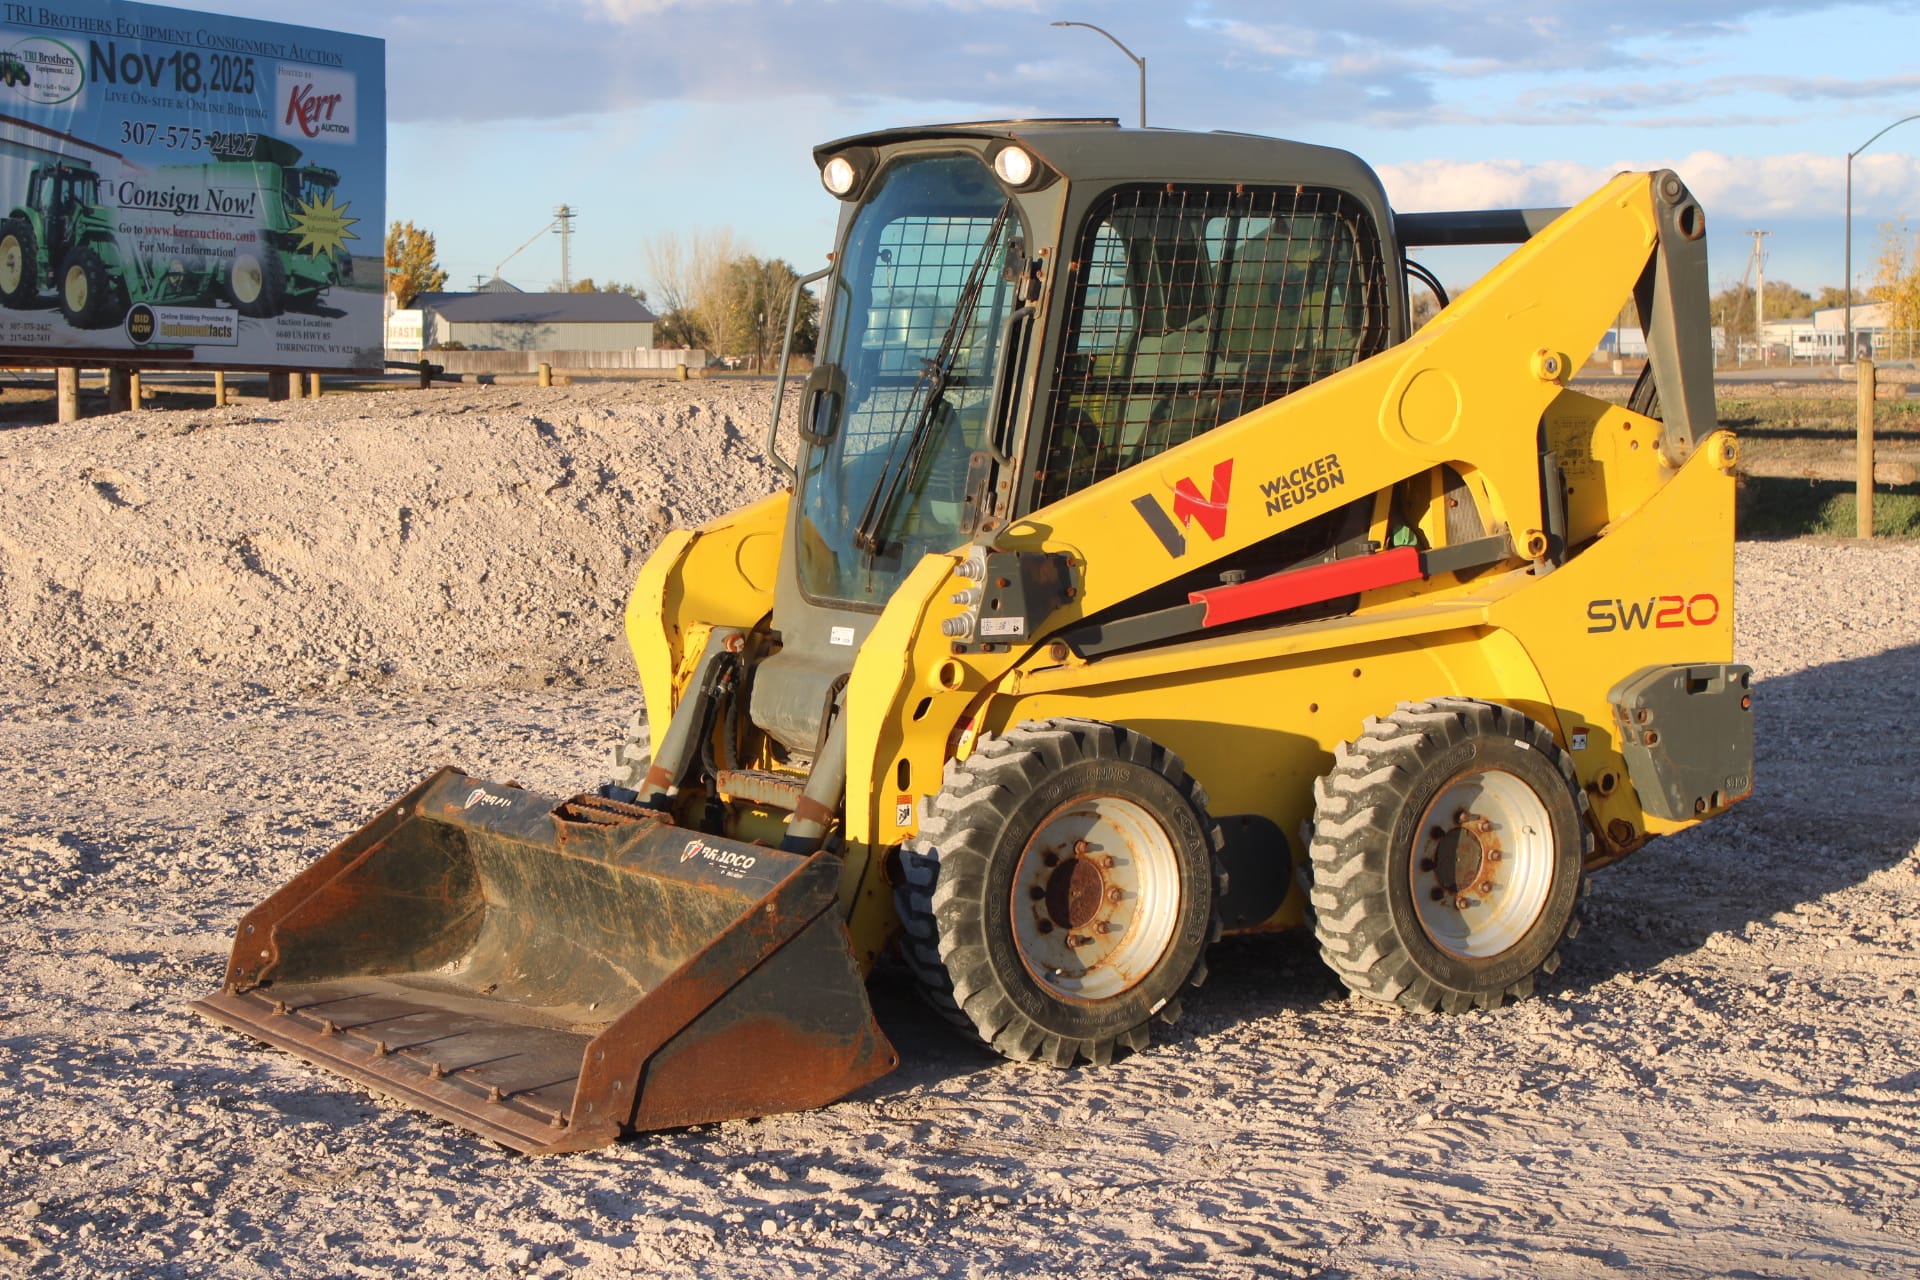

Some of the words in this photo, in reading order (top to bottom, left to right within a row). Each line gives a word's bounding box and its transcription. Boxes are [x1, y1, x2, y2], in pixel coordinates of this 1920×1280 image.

[4, 3, 33, 23] TRI
[38, 7, 112, 33] BROTHERS
[116, 17, 193, 43] EQUIPMENT
[196, 28, 286, 57] CONSIGNMENT
[289, 42, 344, 65] AUCTION
[23, 50, 37, 61] TRI
[39, 52, 74, 65] Brothers
[89, 40, 165, 87] Nov
[209, 53, 255, 94] 2025
[104, 88, 129, 101] LIVE
[175, 99, 184, 110] &
[186, 97, 225, 114] ONLINE
[227, 103, 268, 120] BIDDING
[285, 83, 343, 138] Kerr
[120, 120, 259, 158] 307-575-2427
[320, 123, 350, 134] AUCTION
[118, 181, 200, 217] Consign
[205, 188, 257, 216] Now!
[119, 222, 132, 234] Go
[134, 224, 143, 235] to
[144, 223, 257, 243] www.kerrauction.com
[139, 240, 155, 253] For
[156, 242, 179, 255] More
[181, 243, 236, 258] Information!
[133, 313, 150, 324] BID
[160, 313, 178, 321] Online
[179, 313, 200, 323] Bidding
[201, 314, 224, 322] Provided
[225, 315, 233, 323] By
[277, 318, 301, 327] Auction
[131, 324, 151, 334] NOW
[292, 330, 302, 340] US
[303, 331, 321, 341] HWY
[275, 342, 327, 353] TORRINGTON,
[329, 344, 340, 354] WY
[1258, 453, 1342, 498] WACKER
[1265, 468, 1345, 517] NEUSON
[1586, 593, 1720, 634] SW20
